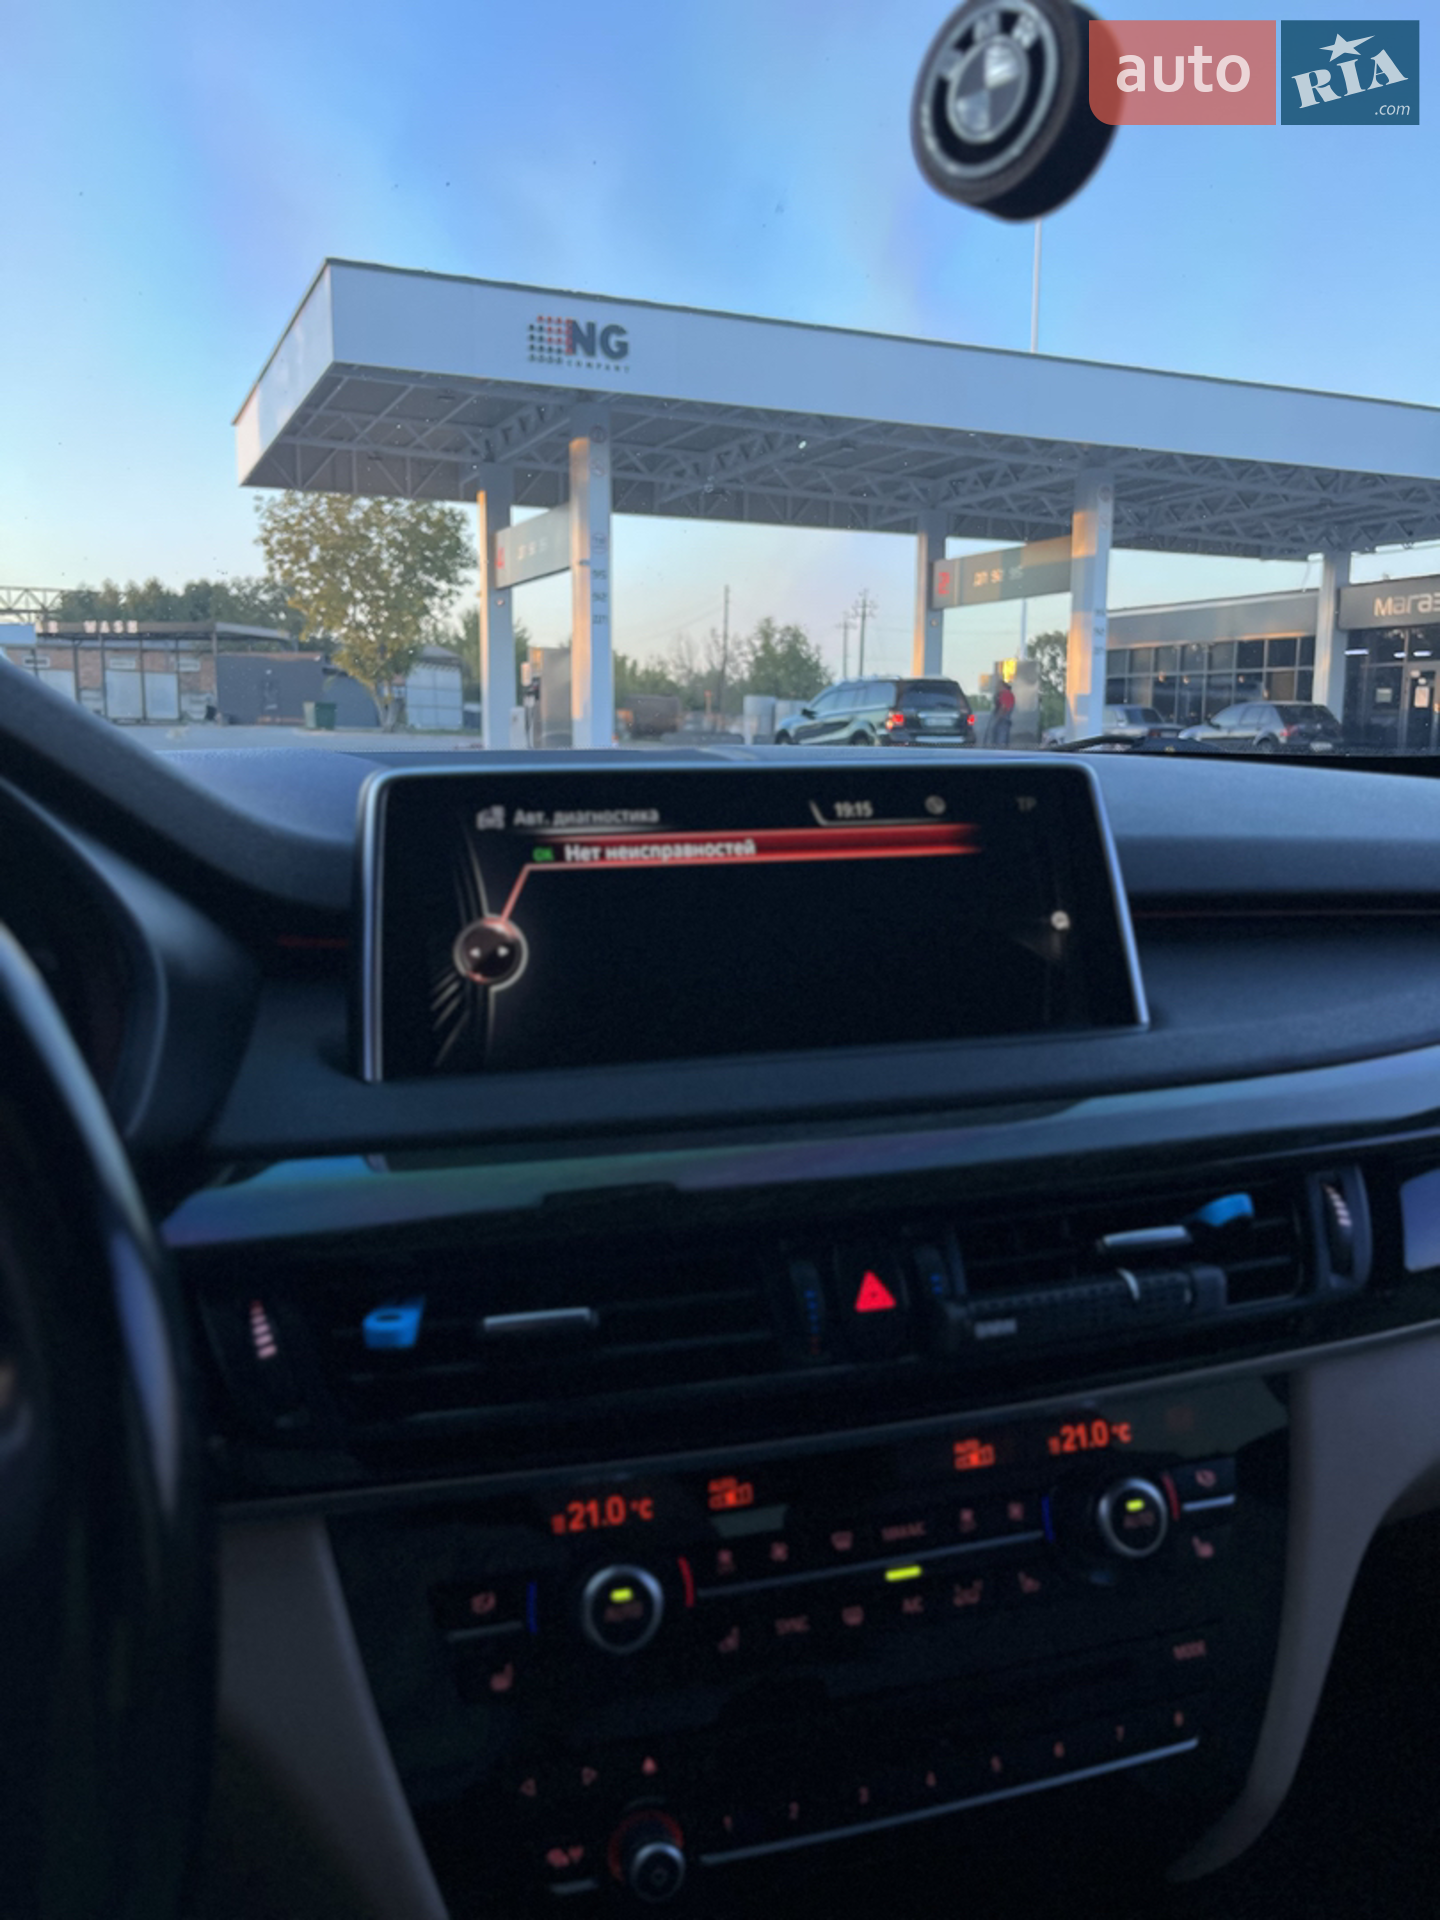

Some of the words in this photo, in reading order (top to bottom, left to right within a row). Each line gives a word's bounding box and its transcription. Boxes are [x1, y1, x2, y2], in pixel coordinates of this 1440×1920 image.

[513, 808, 549, 827] Авт.
[552, 805, 660, 829] диагностика
[834, 801, 873, 818] 19:15
[564, 843, 602, 862] Нет
[605, 839, 757, 863] неисправностей
[1061, 1419, 1109, 1454] 21.0
[567, 1493, 627, 1532] 21.0
